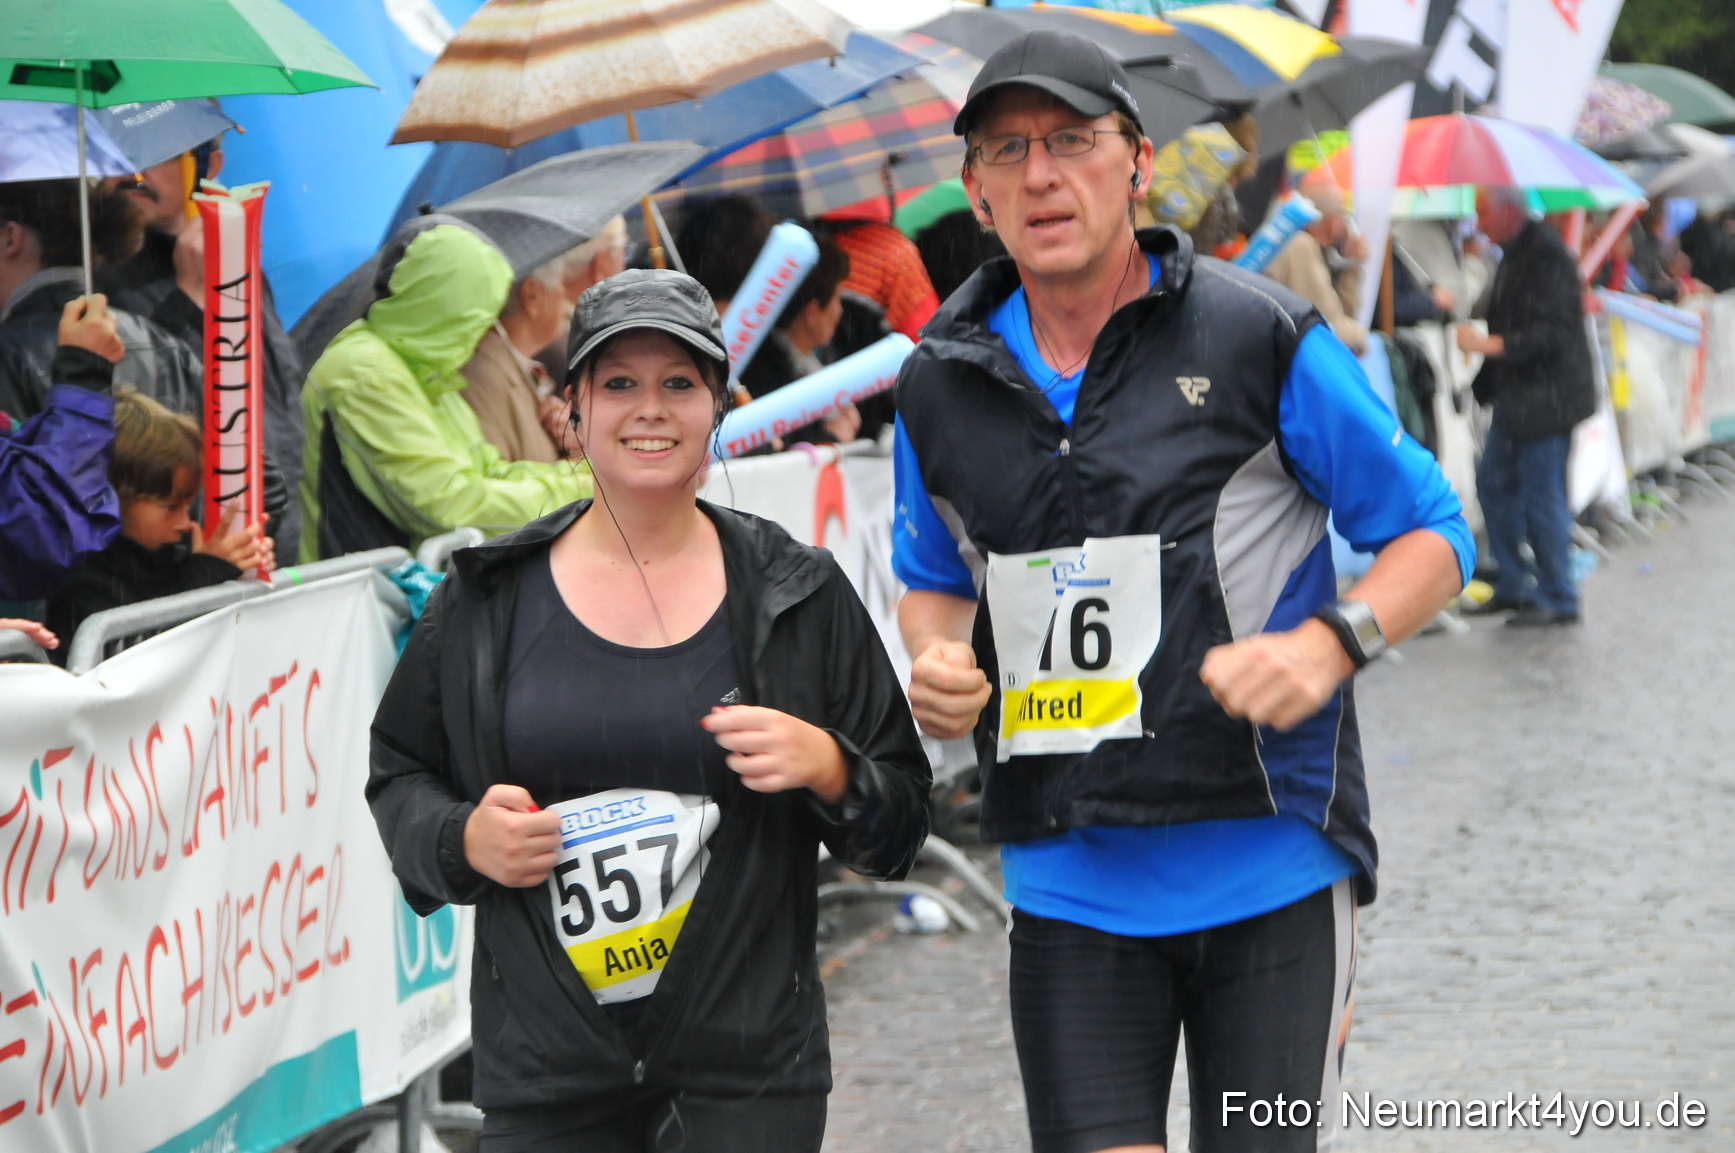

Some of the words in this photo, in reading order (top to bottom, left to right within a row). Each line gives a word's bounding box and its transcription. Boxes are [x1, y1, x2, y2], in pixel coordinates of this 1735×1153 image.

[212, 271, 251, 515] AUSTRIA
[772, 374, 897, 436] ReiseCente
[559, 796, 648, 836] BOCK
[553, 832, 680, 938] 557
[604, 936, 670, 978] Anja
